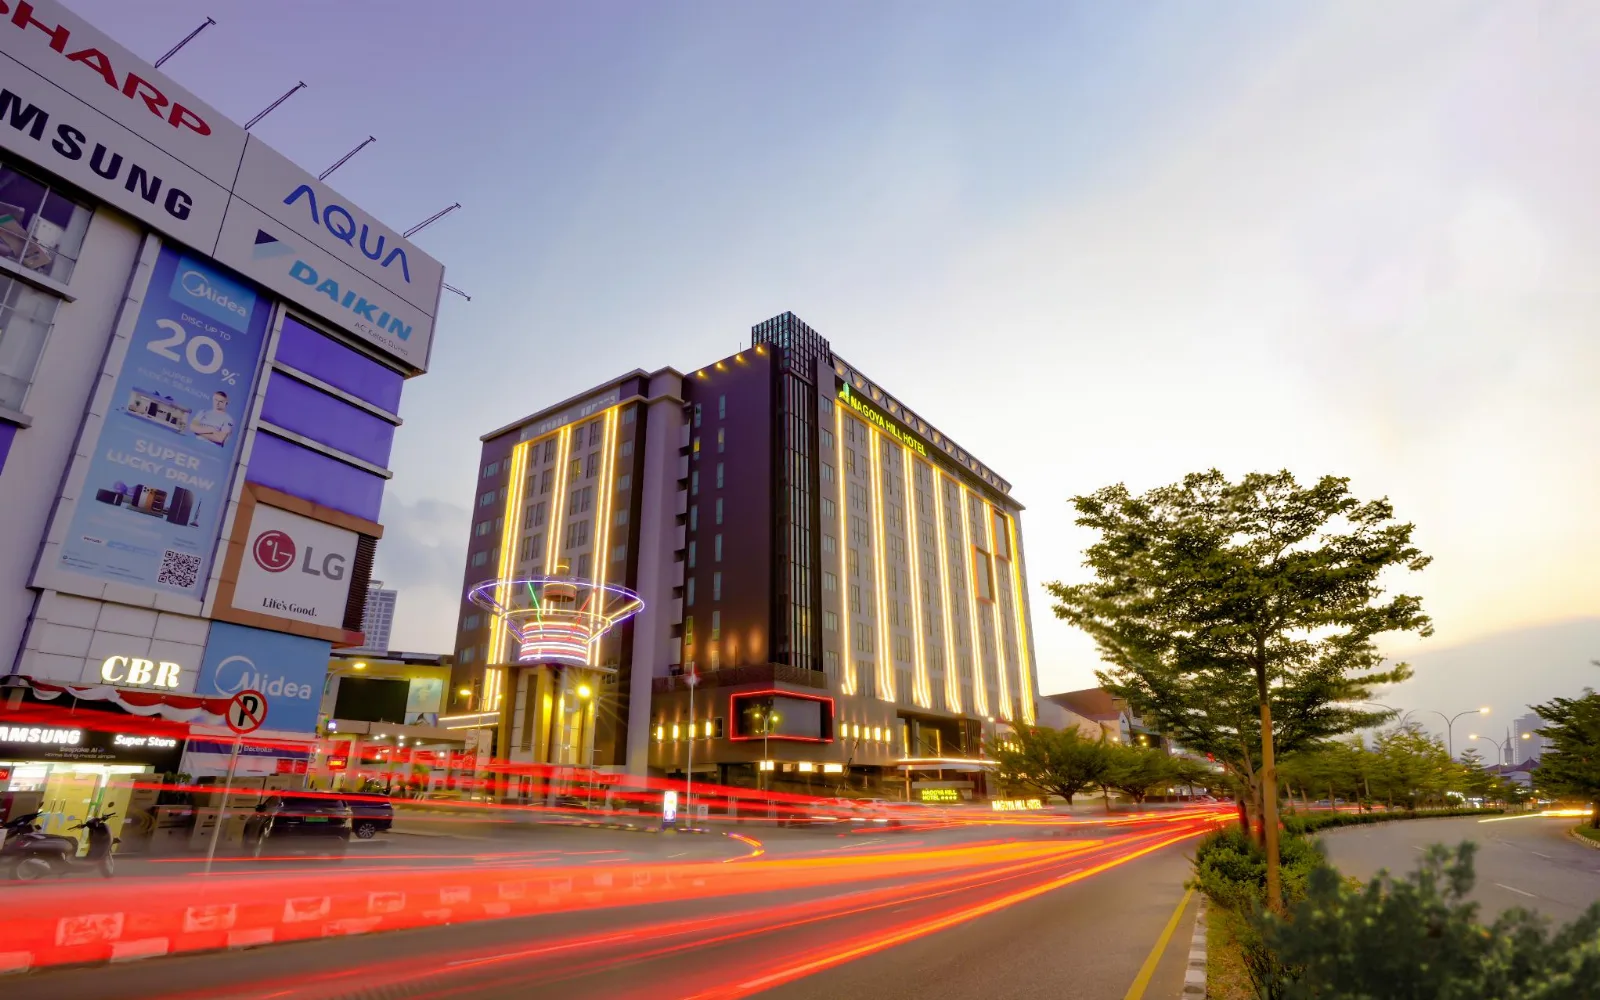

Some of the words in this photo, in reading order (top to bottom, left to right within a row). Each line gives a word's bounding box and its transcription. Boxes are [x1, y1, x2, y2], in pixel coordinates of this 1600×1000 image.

[0, 0, 211, 136] HARP
[283, 184, 411, 283] AQUA
[193, 281, 247, 317] Midea
[288, 260, 412, 341] DAIKIN
[181, 312, 203, 328] DISC
[205, 324, 218, 334] UP
[220, 330, 231, 341] TO
[850, 395, 885, 428] NAGOYA
[885, 420, 903, 441] HILL
[903, 432, 927, 457] HOTEL
[106, 449, 164, 476] LUCKY
[165, 467, 215, 491] DRAW
[134, 438, 200, 471] SUPER
[302, 546, 346, 581] LG
[101, 655, 180, 688] CBR
[228, 671, 312, 699] Midea
[114, 735, 146, 747] Super
[147, 736, 177, 747] Store
